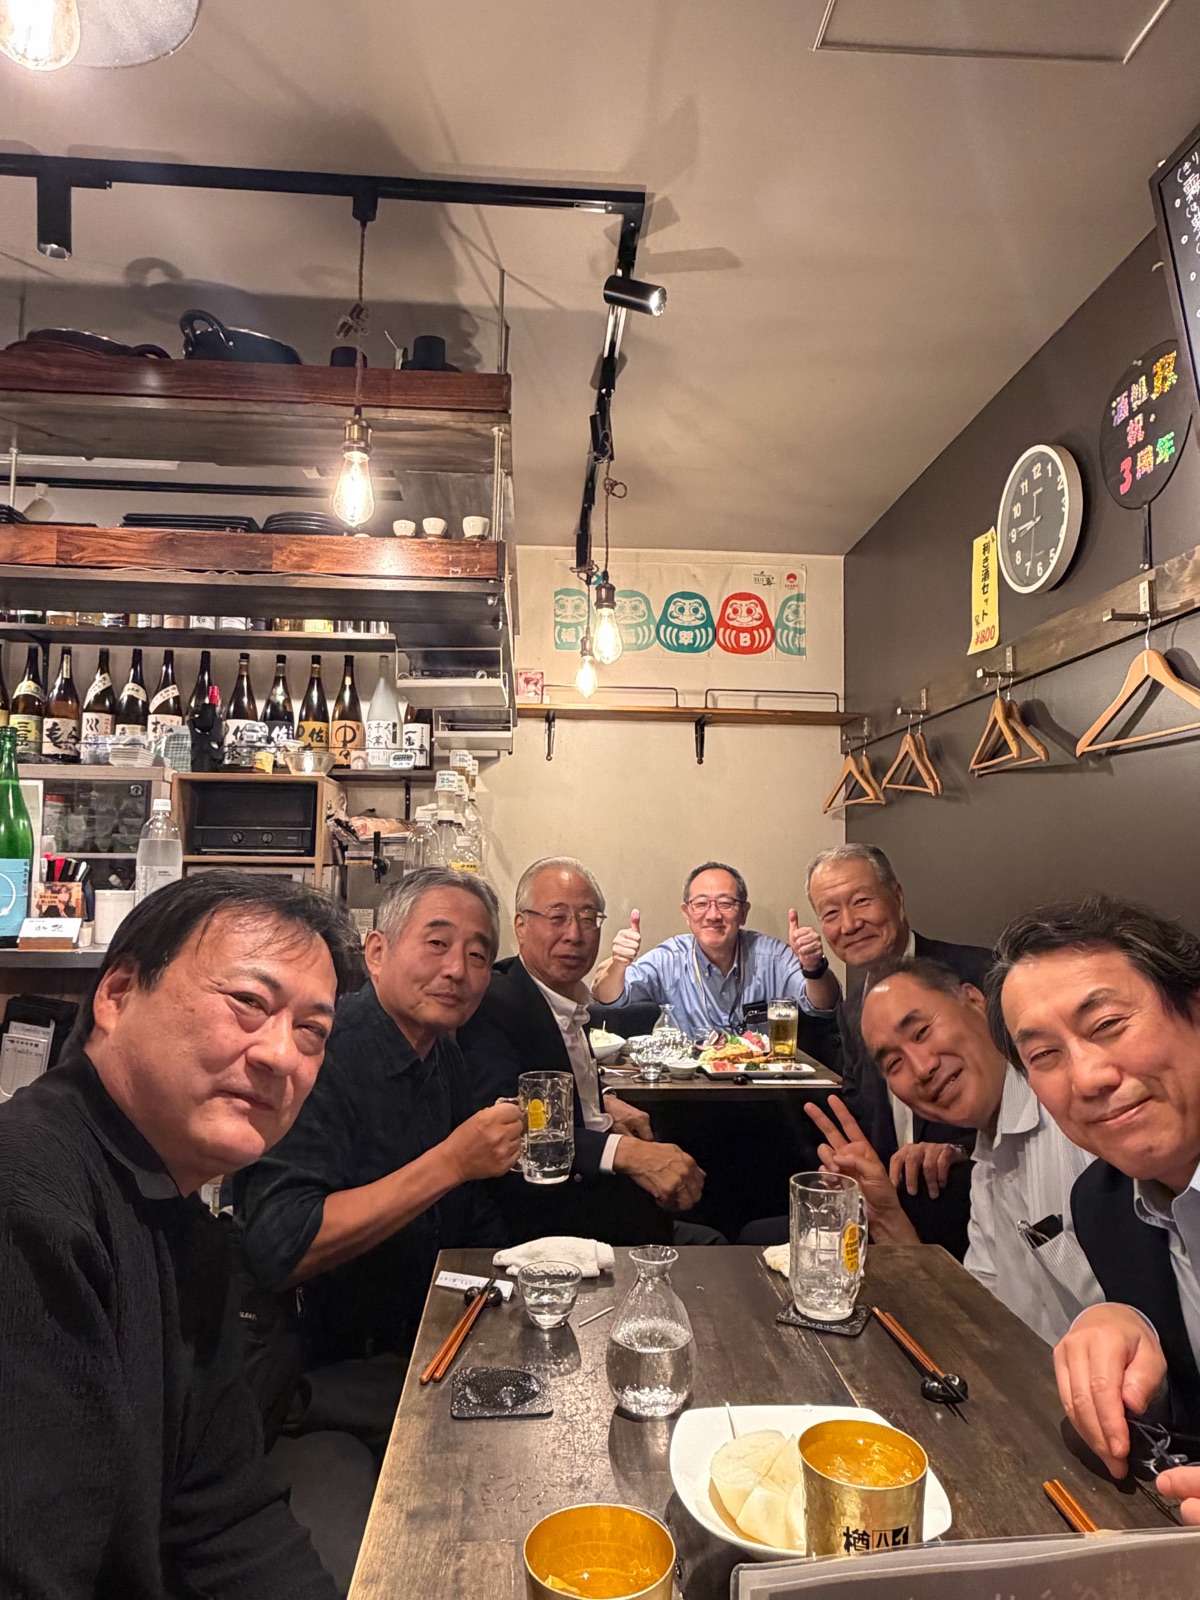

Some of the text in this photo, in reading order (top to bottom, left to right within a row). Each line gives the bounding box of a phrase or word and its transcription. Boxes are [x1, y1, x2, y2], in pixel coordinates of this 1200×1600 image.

[1032, 462, 1042, 480] 12
[1047, 462, 1052, 477] 1
[1020, 479, 1028, 495] 11
[1057, 474, 1064, 491] 2
[1012, 502, 1021, 519] 10
[1010, 528, 1017, 543] 9
[1015, 549, 1022, 565] 8
[1049, 547, 1056, 563] 5
[1025, 561, 1031, 576] 7
[1036, 561, 1043, 577] 6
[739, 631, 751, 648] B
[974, 624, 996, 646] ¥800
